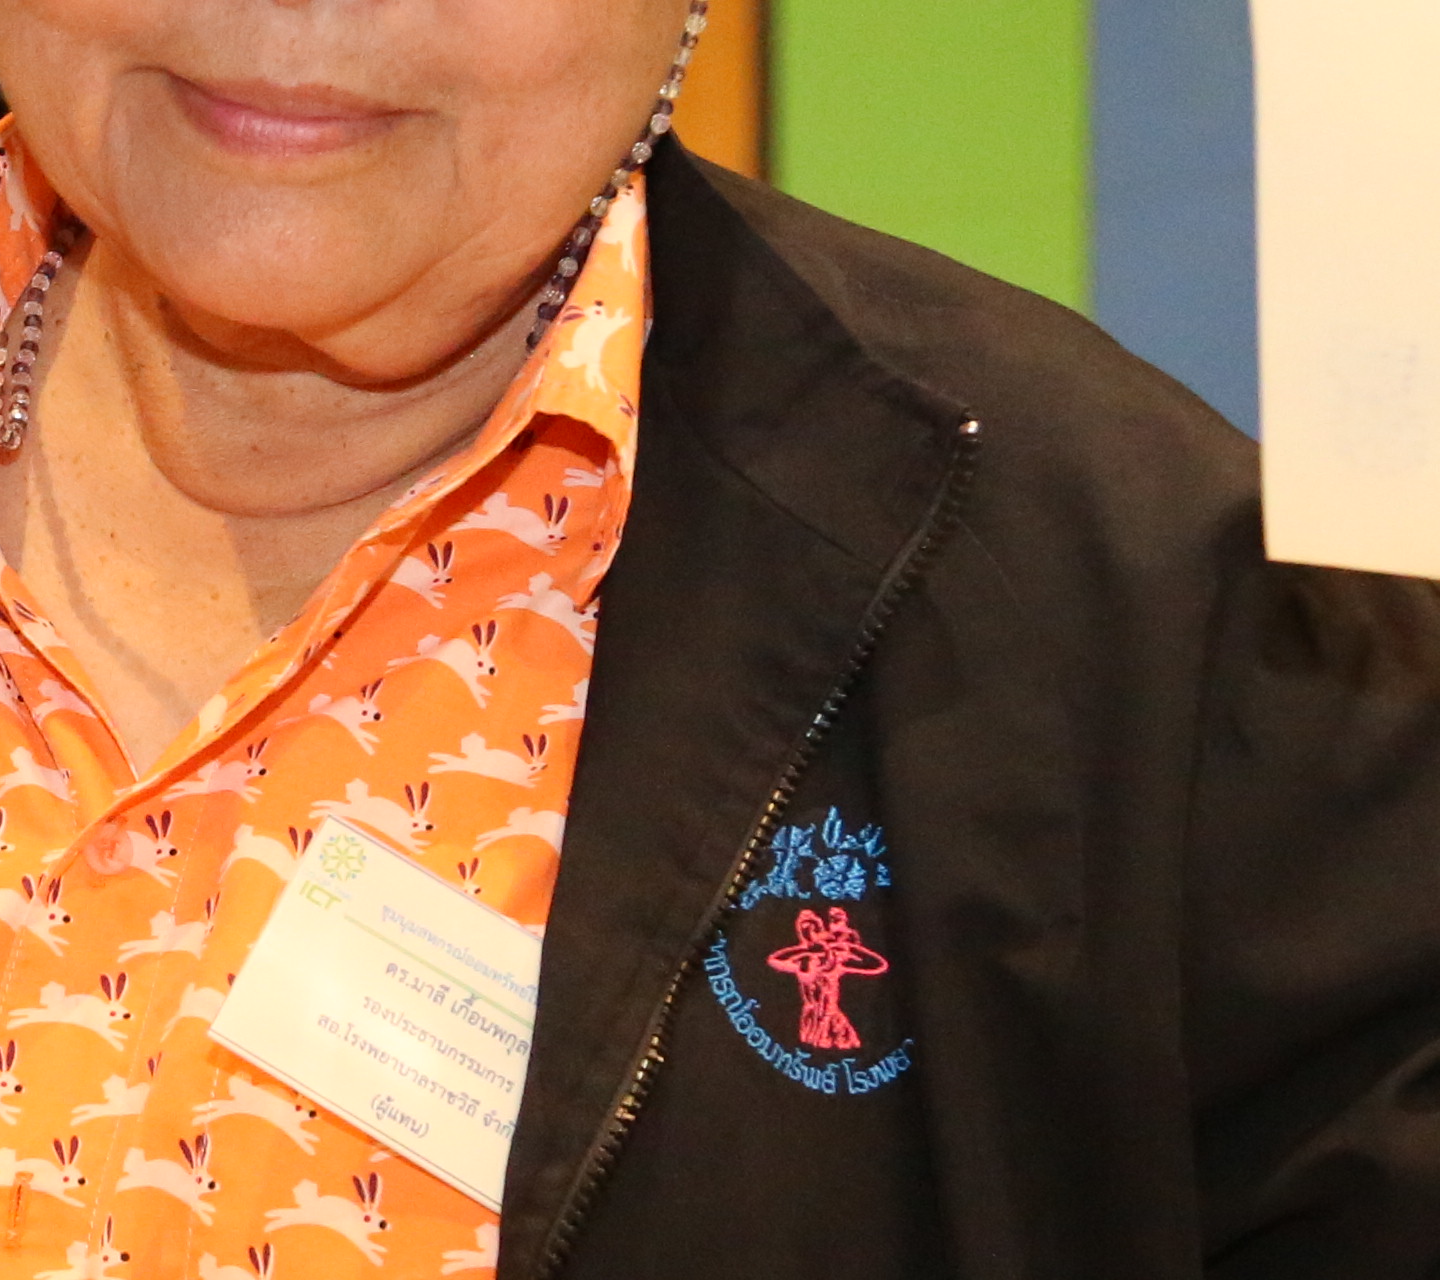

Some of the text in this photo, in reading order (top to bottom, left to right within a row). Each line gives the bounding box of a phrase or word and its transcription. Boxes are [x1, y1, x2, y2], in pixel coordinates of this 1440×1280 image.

[363, 996, 515, 1093] รองประธานกรรมการ
[371, 1094, 430, 1138] (ผู้แทน)
